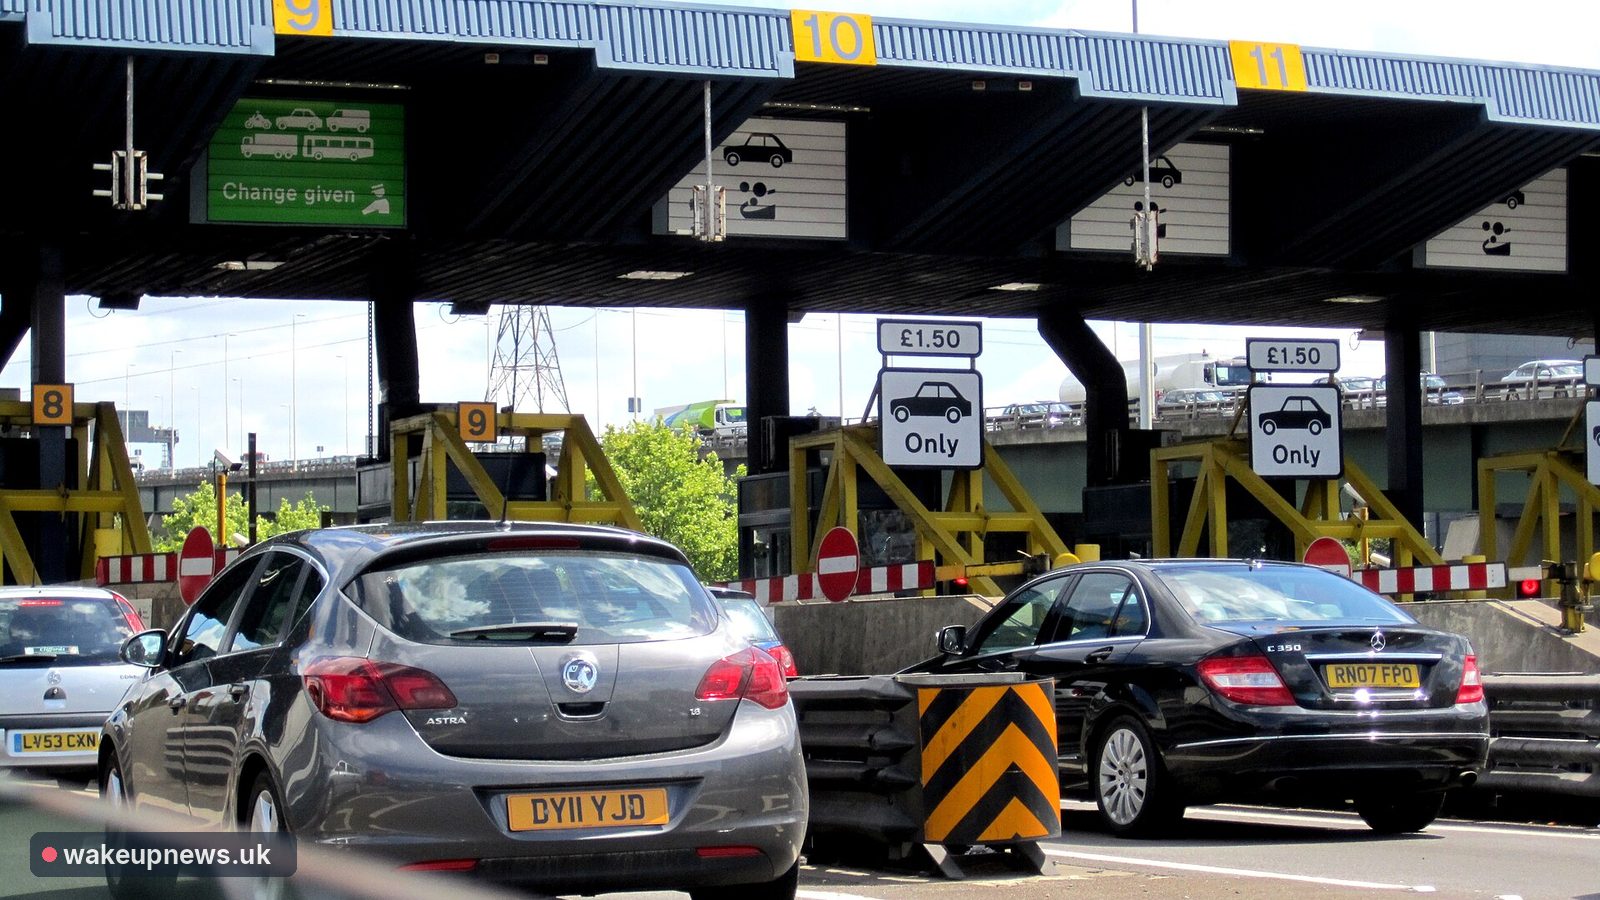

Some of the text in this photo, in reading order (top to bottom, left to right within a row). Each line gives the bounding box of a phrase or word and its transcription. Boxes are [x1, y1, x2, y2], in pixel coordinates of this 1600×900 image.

[285, 0, 319, 31] 9
[804, 13, 863, 60] 10
[1250, 45, 1288, 87] 11
[222, 182, 355, 205] Change given
[900, 328, 960, 348] £1.50
[1267, 346, 1320, 365] £1.50
[43, 390, 63, 418] 8
[468, 409, 486, 436] 9
[905, 432, 959, 458] Only
[1273, 444, 1320, 468] Only
[1277, 644, 1301, 652] 350
[1335, 665, 1412, 683] RN07 FPO
[425, 717, 467, 725] ASTRA
[23, 733, 96, 749] LV53 CXN
[531, 794, 645, 824] DY11 YJD
